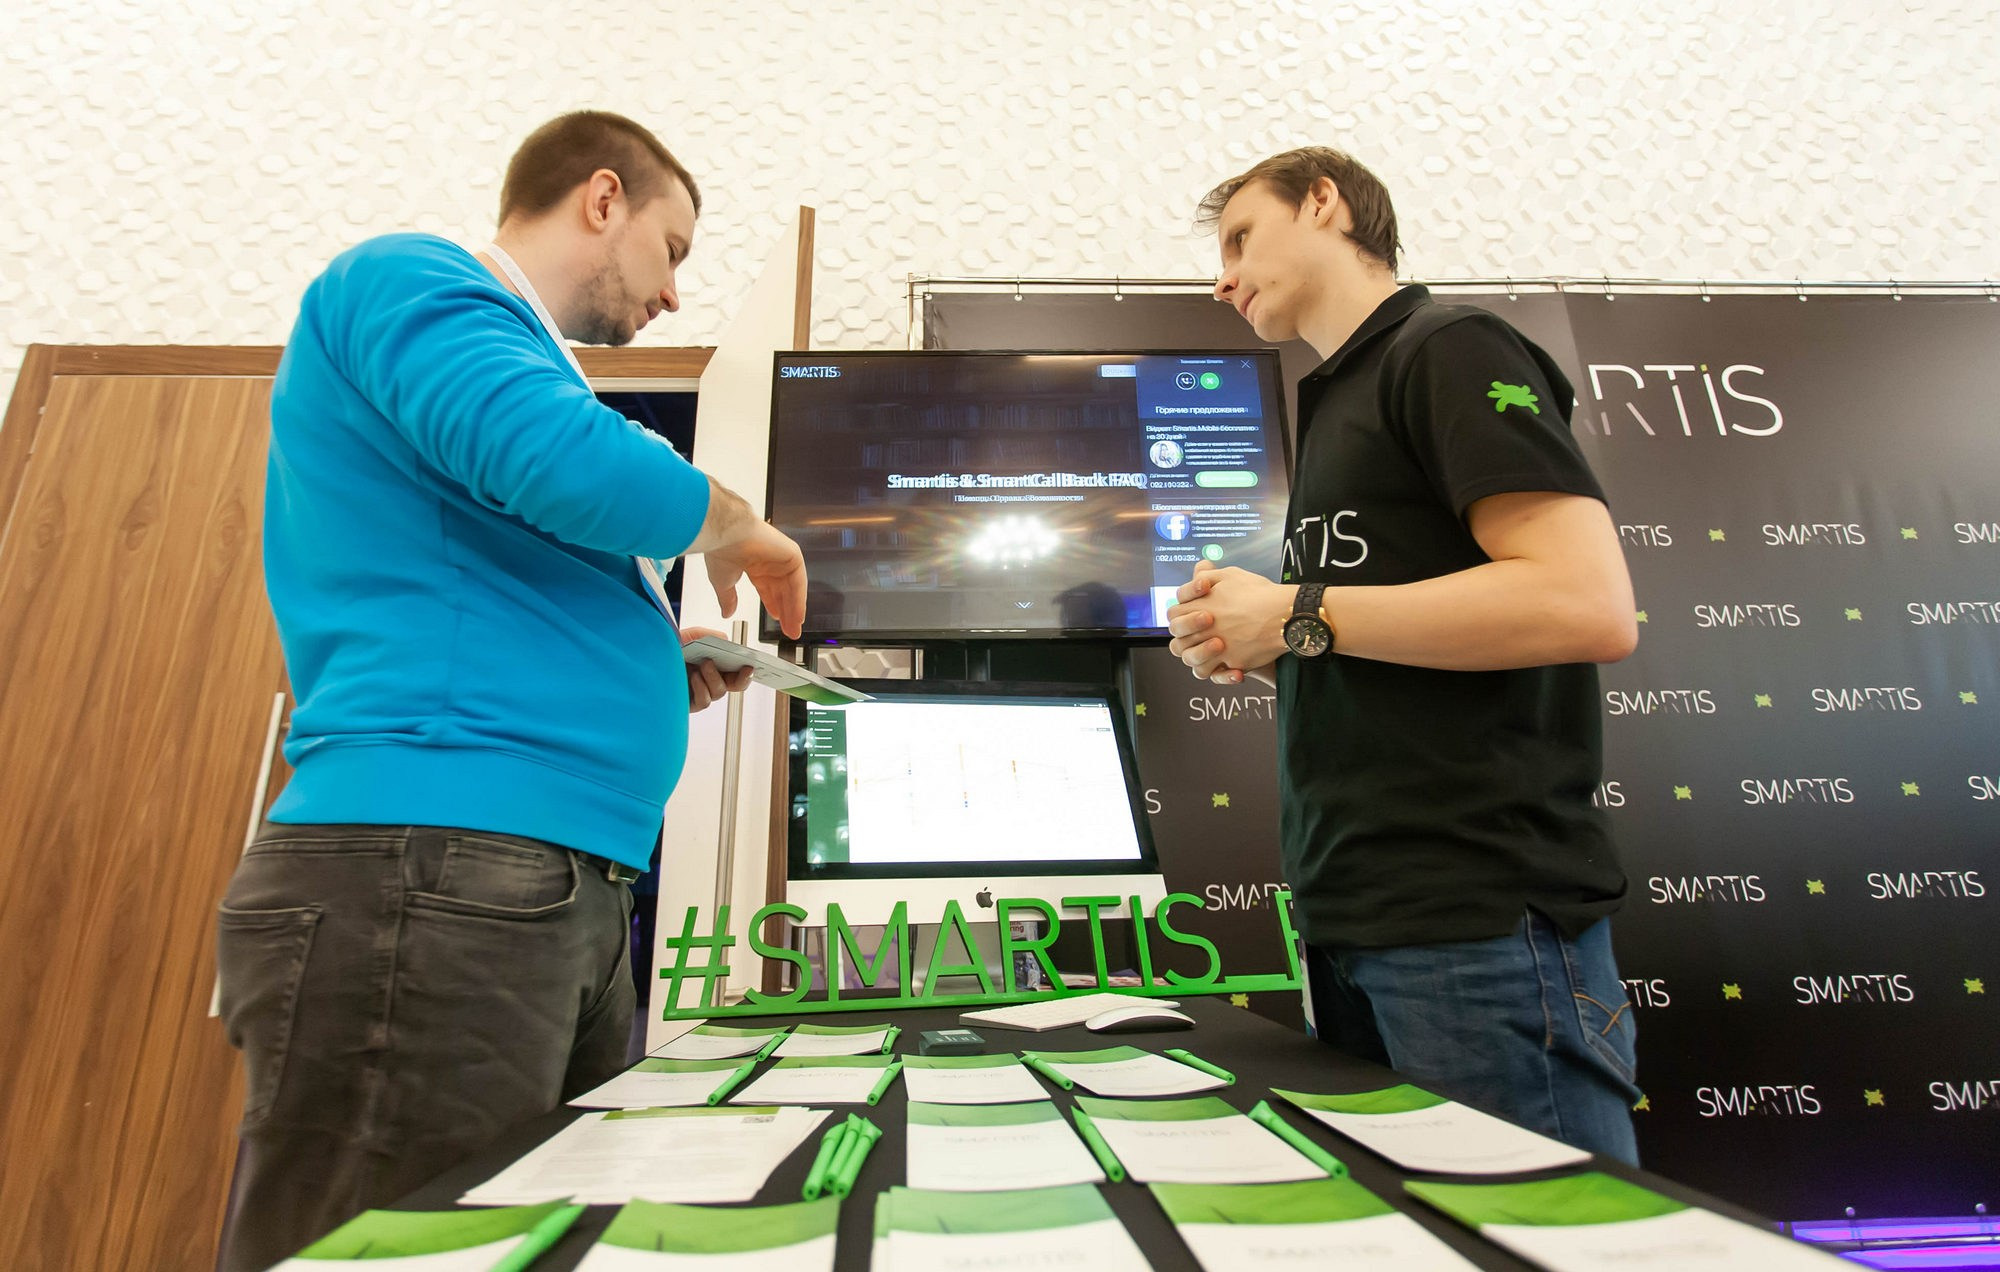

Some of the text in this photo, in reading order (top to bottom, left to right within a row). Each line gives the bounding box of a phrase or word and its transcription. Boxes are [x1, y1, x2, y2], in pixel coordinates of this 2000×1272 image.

[780, 366, 841, 378] SMARTIS
[1620, 525, 1673, 547] RTIS
[1762, 523, 1865, 546] SMARTIS
[1695, 604, 1800, 628] SMARTIS
[1606, 690, 1716, 715] SMARTIS
[1812, 687, 1921, 712] SMARTIS
[1741, 778, 1854, 804] SMARTIS
[1649, 875, 1765, 903] SMARTIS
[1867, 871, 1985, 899] SMARTIS
[1793, 974, 1914, 1004] SMARTIS
[1697, 1085, 1821, 1117] SMARTIS
